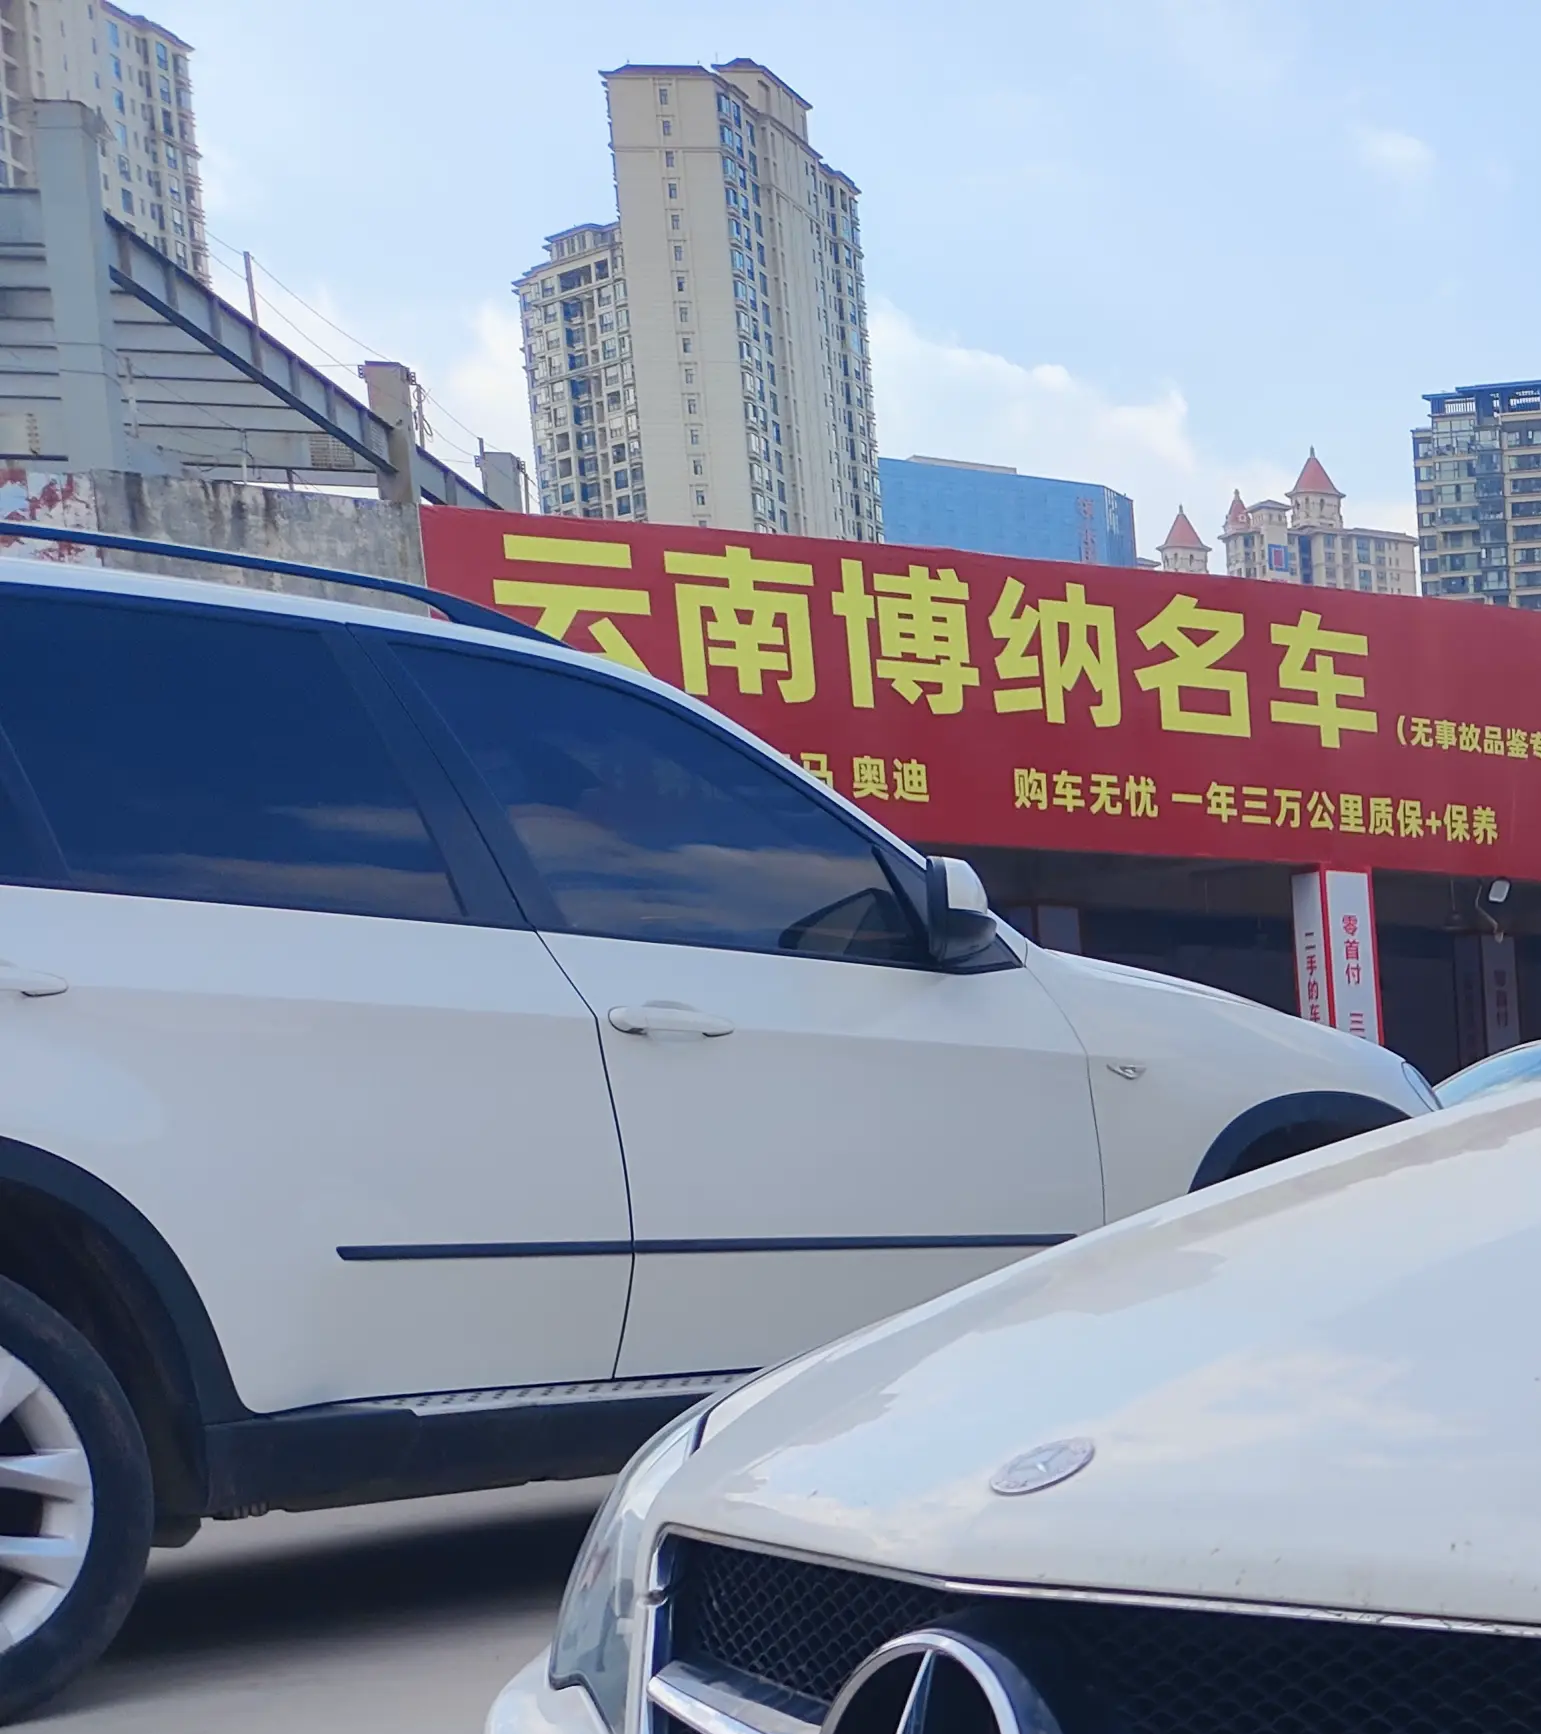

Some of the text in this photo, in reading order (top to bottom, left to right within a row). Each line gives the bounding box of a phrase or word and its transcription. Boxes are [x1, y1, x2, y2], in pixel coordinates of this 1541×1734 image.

[493, 534, 1378, 749] 云南博纳名车
[852, 755, 930, 802] 奥迪
[1014, 767, 1158, 818] 购车无忧
[1172, 781, 1498, 845] 一年三万公里质保+保养
[1342, 914, 1361, 986] 零首付
